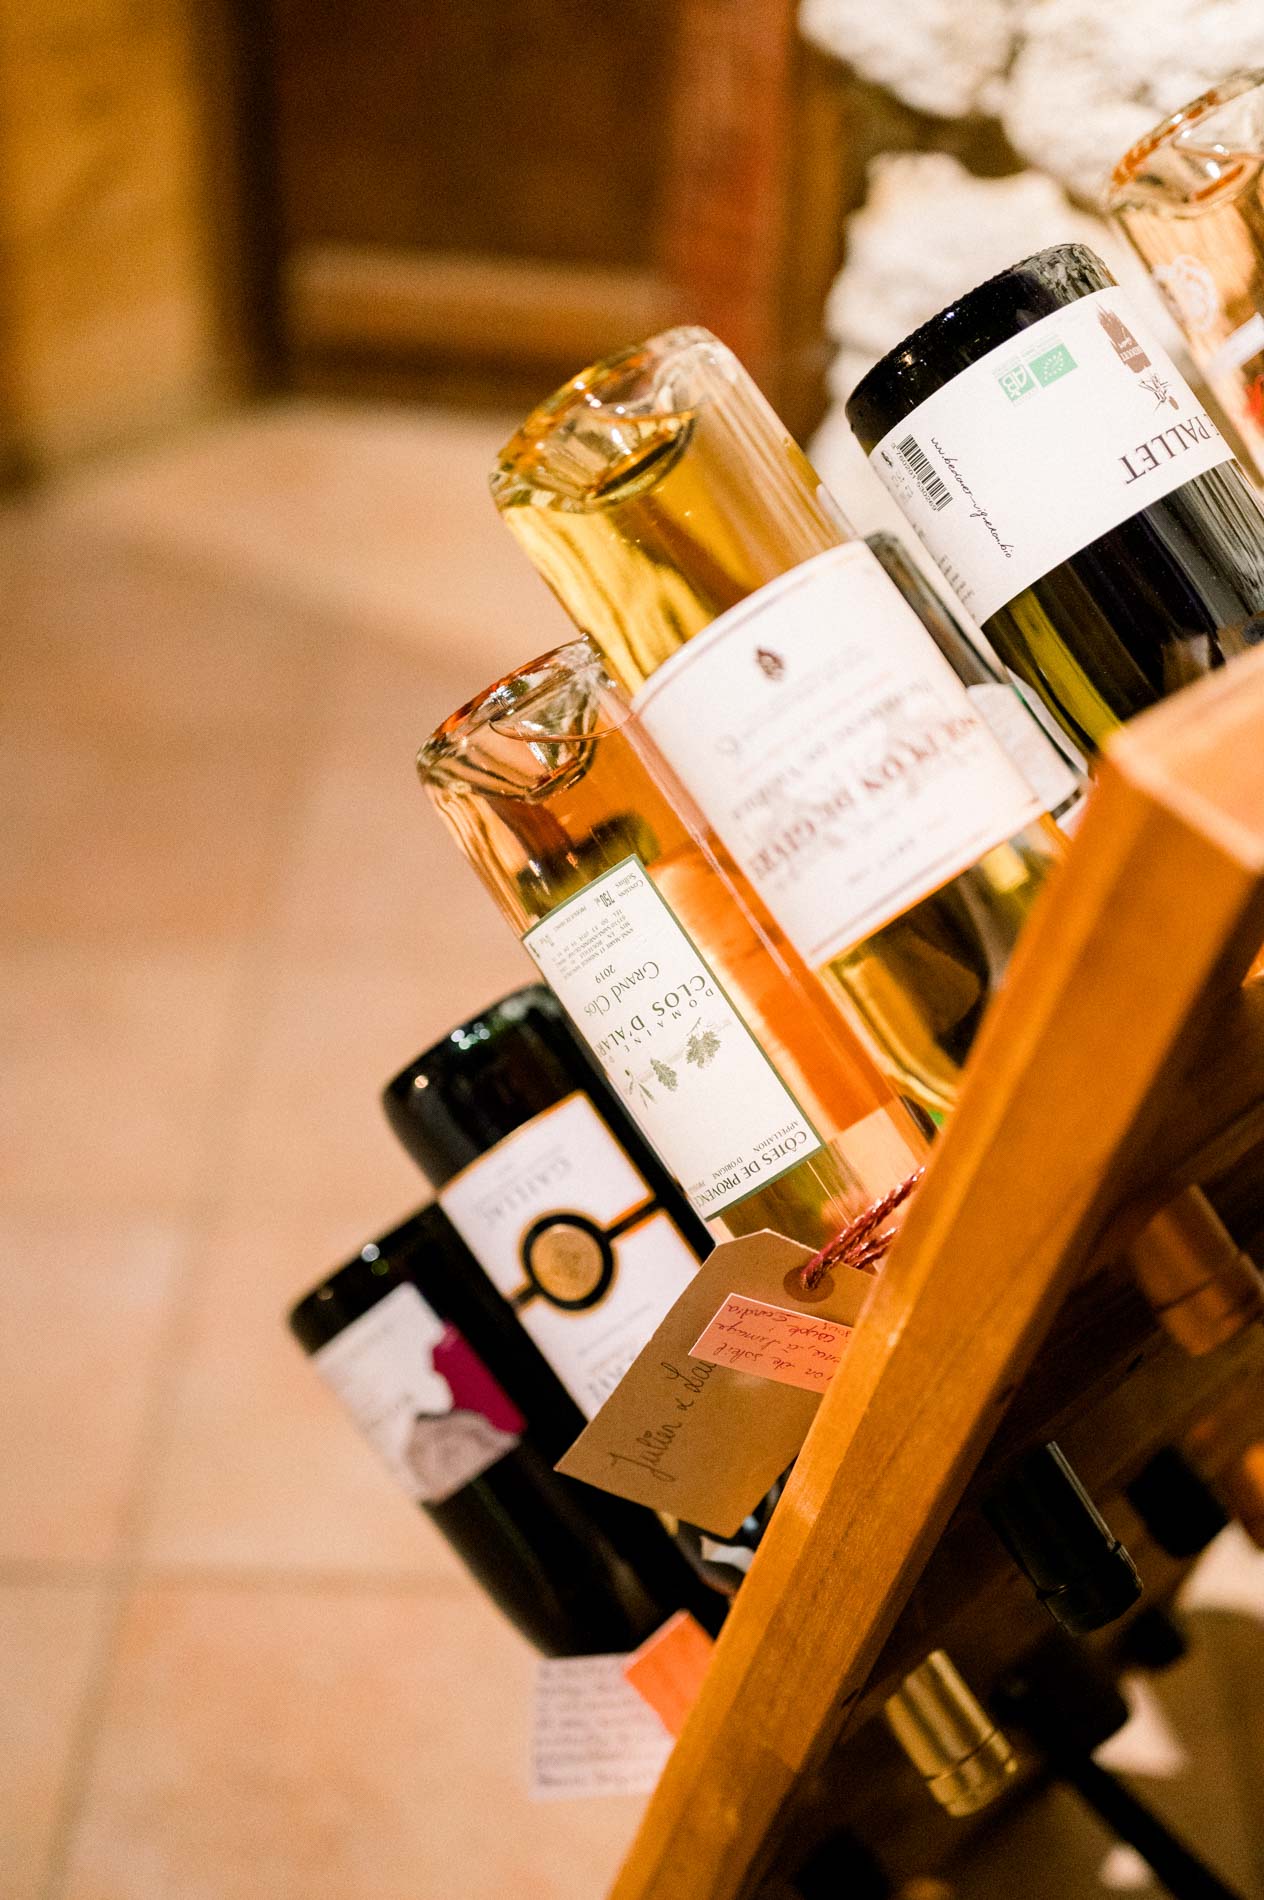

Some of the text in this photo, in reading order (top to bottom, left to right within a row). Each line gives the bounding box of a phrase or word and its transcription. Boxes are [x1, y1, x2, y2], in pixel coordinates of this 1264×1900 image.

[1001, 366, 1028, 395] AB
[1118, 415, 1212, 485] PALLET
[916, 480, 938, 511] 530269
[595, 964, 616, 984] 2019
[584, 995, 611, 1016] Clos
[652, 975, 707, 1017] CLOS
[624, 988, 714, 1052] DOMAINE
[752, 1120, 800, 1153] APPELLATION
[761, 1131, 808, 1166] CÔTES
[741, 1160, 762, 1180] DE
[609, 1422, 683, 1483] Julien
[660, 1361, 718, 1394] Lau
